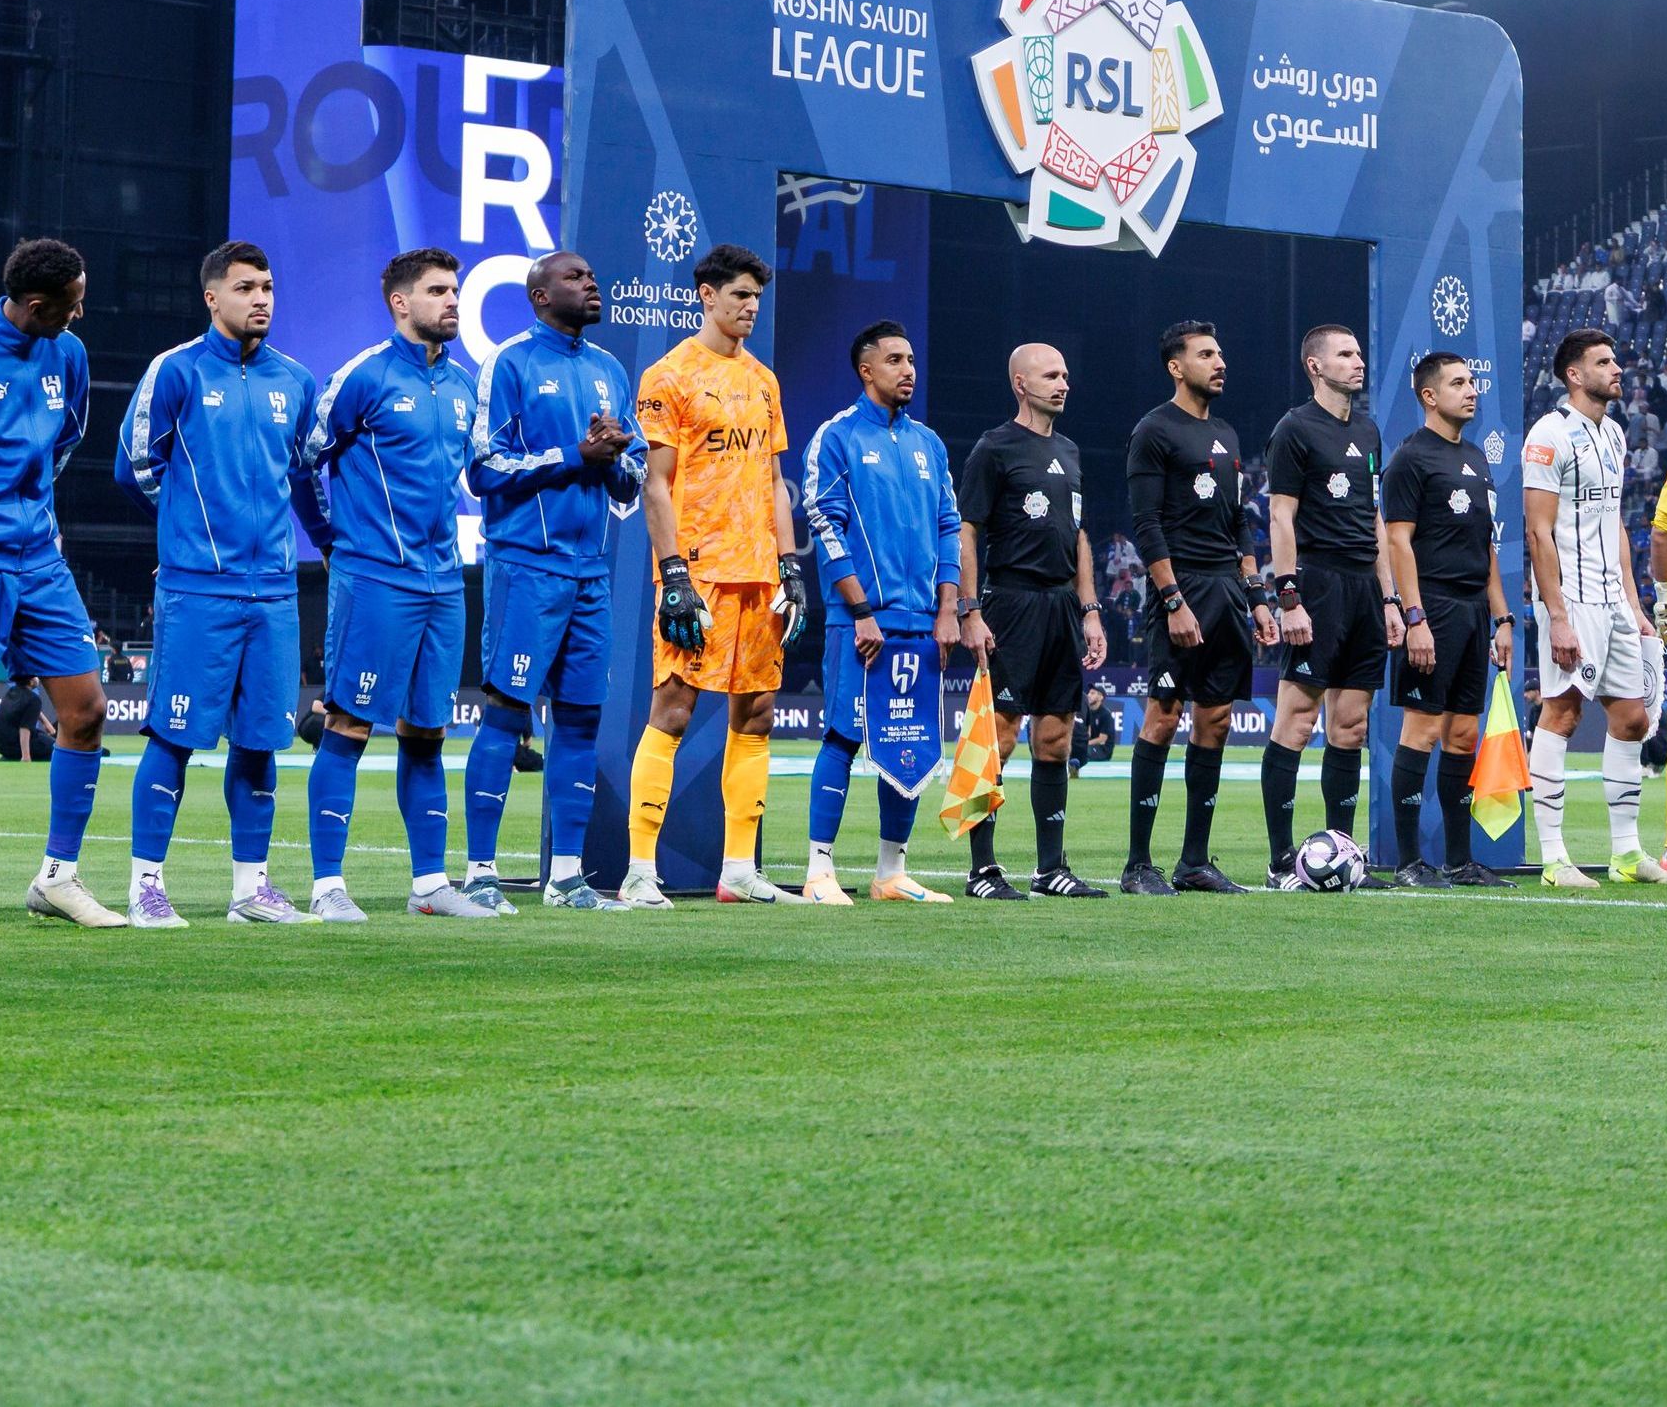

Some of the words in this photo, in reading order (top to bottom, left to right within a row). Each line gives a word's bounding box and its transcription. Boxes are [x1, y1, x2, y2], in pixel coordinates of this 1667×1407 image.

[860, 2, 927, 39] SAUDI
[772, 27, 926, 99] LEAGUE
[1252, 51, 1317, 97] روشن
[1065, 51, 1144, 119] RSL
[1321, 72, 1378, 109] دوري
[1252, 113, 1378, 155] السعودي
[611, 276, 661, 304] روشن
[610, 305, 667, 329] ROSHN
[669, 307, 707, 332] GRO
[706, 427, 769, 454] SAVV
[1571, 486, 1620, 502] JETO
[943, 679, 972, 691] AVVY
[106, 699, 149, 721] OSH
[452, 703, 482, 725] LEA
[773, 708, 809, 729] SHN
[1230, 711, 1266, 733] AUDI
